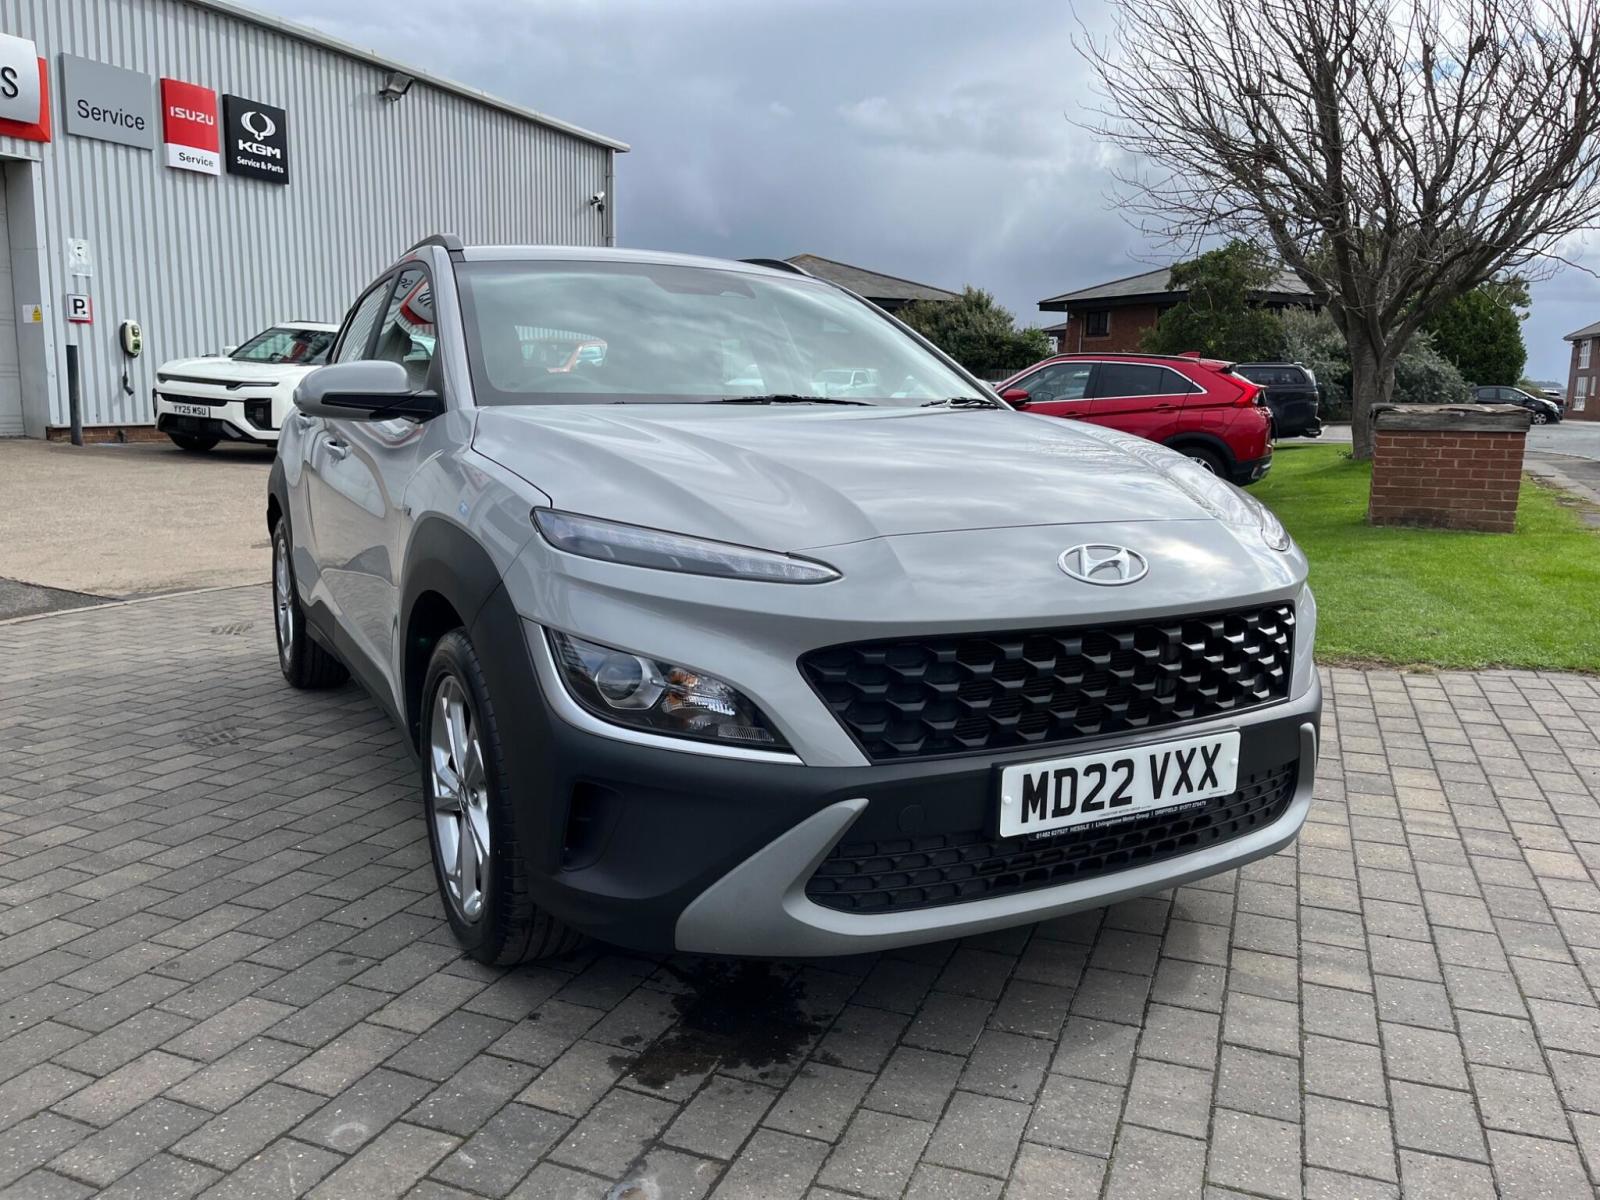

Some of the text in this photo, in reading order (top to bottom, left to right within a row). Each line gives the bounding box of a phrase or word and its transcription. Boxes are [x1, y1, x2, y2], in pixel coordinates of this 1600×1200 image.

[77, 99, 145, 131] Service
[170, 106, 214, 126] ISUZU
[238, 139, 281, 159] KGM
[178, 152, 214, 167] Service
[236, 156, 284, 174] Service & Parts
[72, 298, 85, 315] P
[173, 404, 191, 414] YY25
[1021, 743, 1222, 824] MD22 VXX
